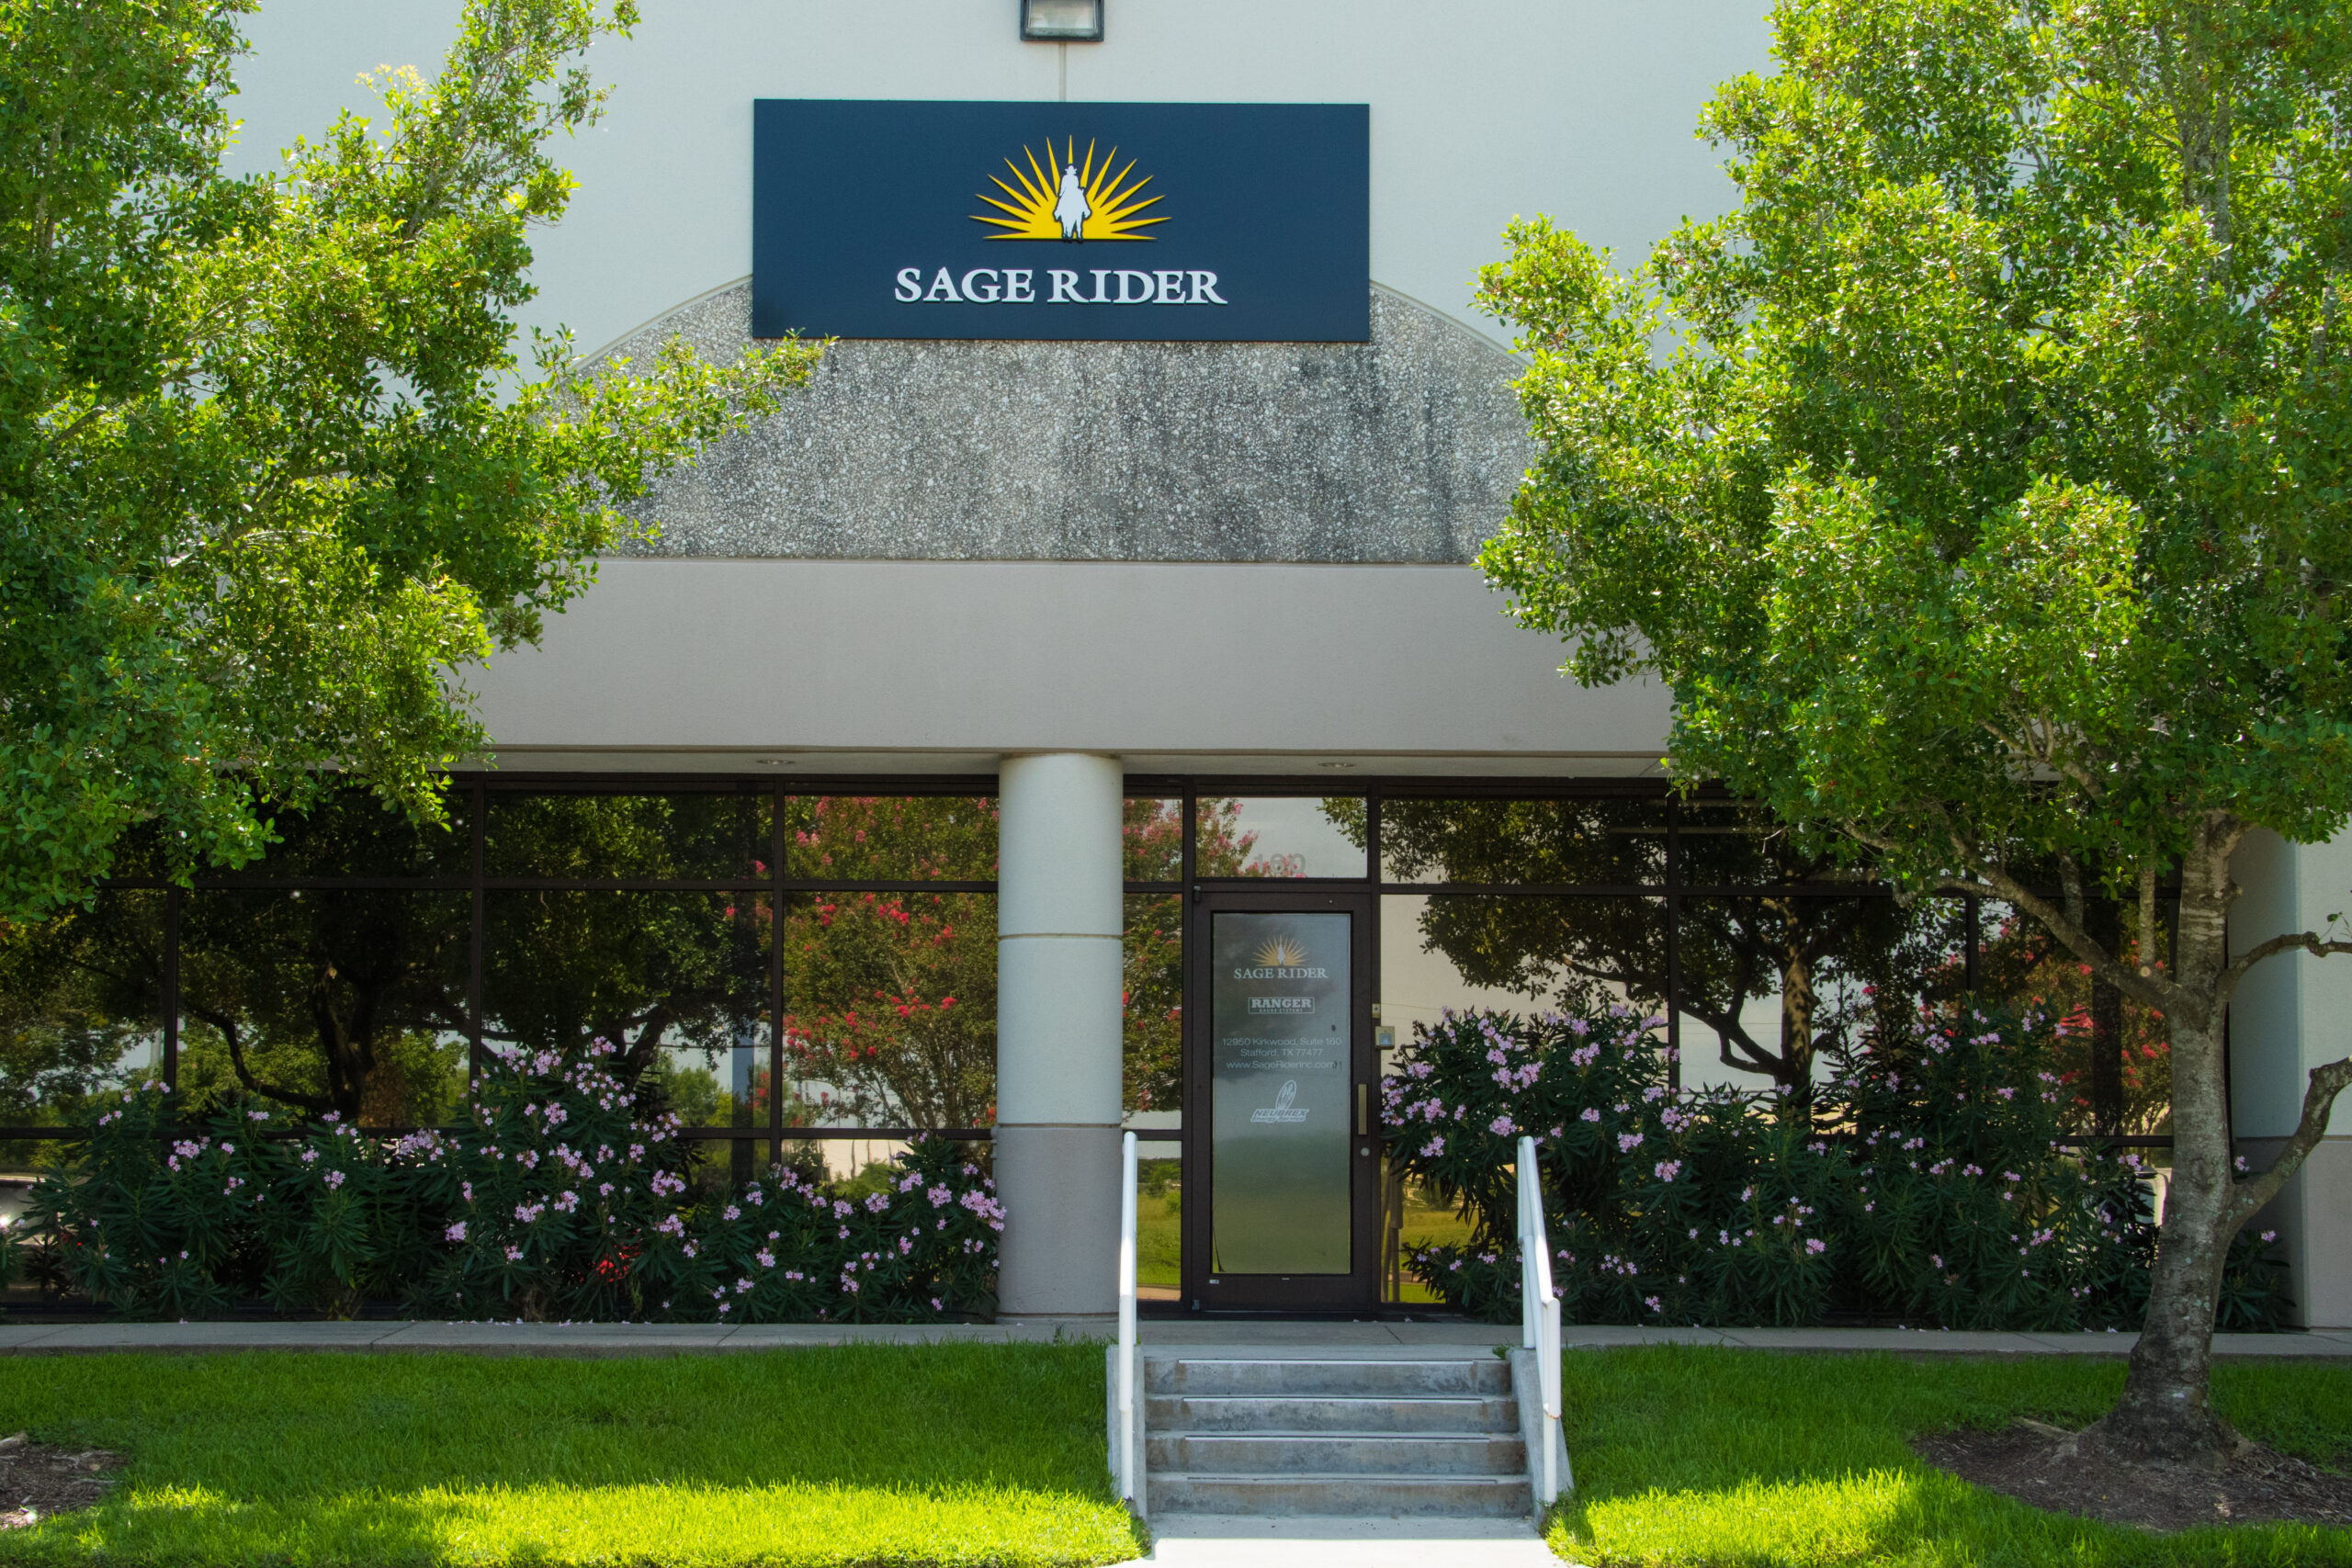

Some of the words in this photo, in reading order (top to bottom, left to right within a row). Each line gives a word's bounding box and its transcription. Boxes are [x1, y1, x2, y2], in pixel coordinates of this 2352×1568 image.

[894, 265, 1036, 304] SAGE
[1046, 269, 1228, 305] RIDER
[1253, 852, 1306, 874] 160
[1233, 967, 1274, 979] SAGE
[1277, 967, 1329, 979] RIDER
[1250, 998, 1312, 1009] RANGER
[1222, 1037, 1251, 1046] 12950
[1300, 1037, 1324, 1046] Suite
[1325, 1037, 1343, 1046] 160
[1282, 1048, 1295, 1057] TX
[1296, 1048, 1324, 1057] 77477
[1253, 1109, 1307, 1117] NEUBREX
